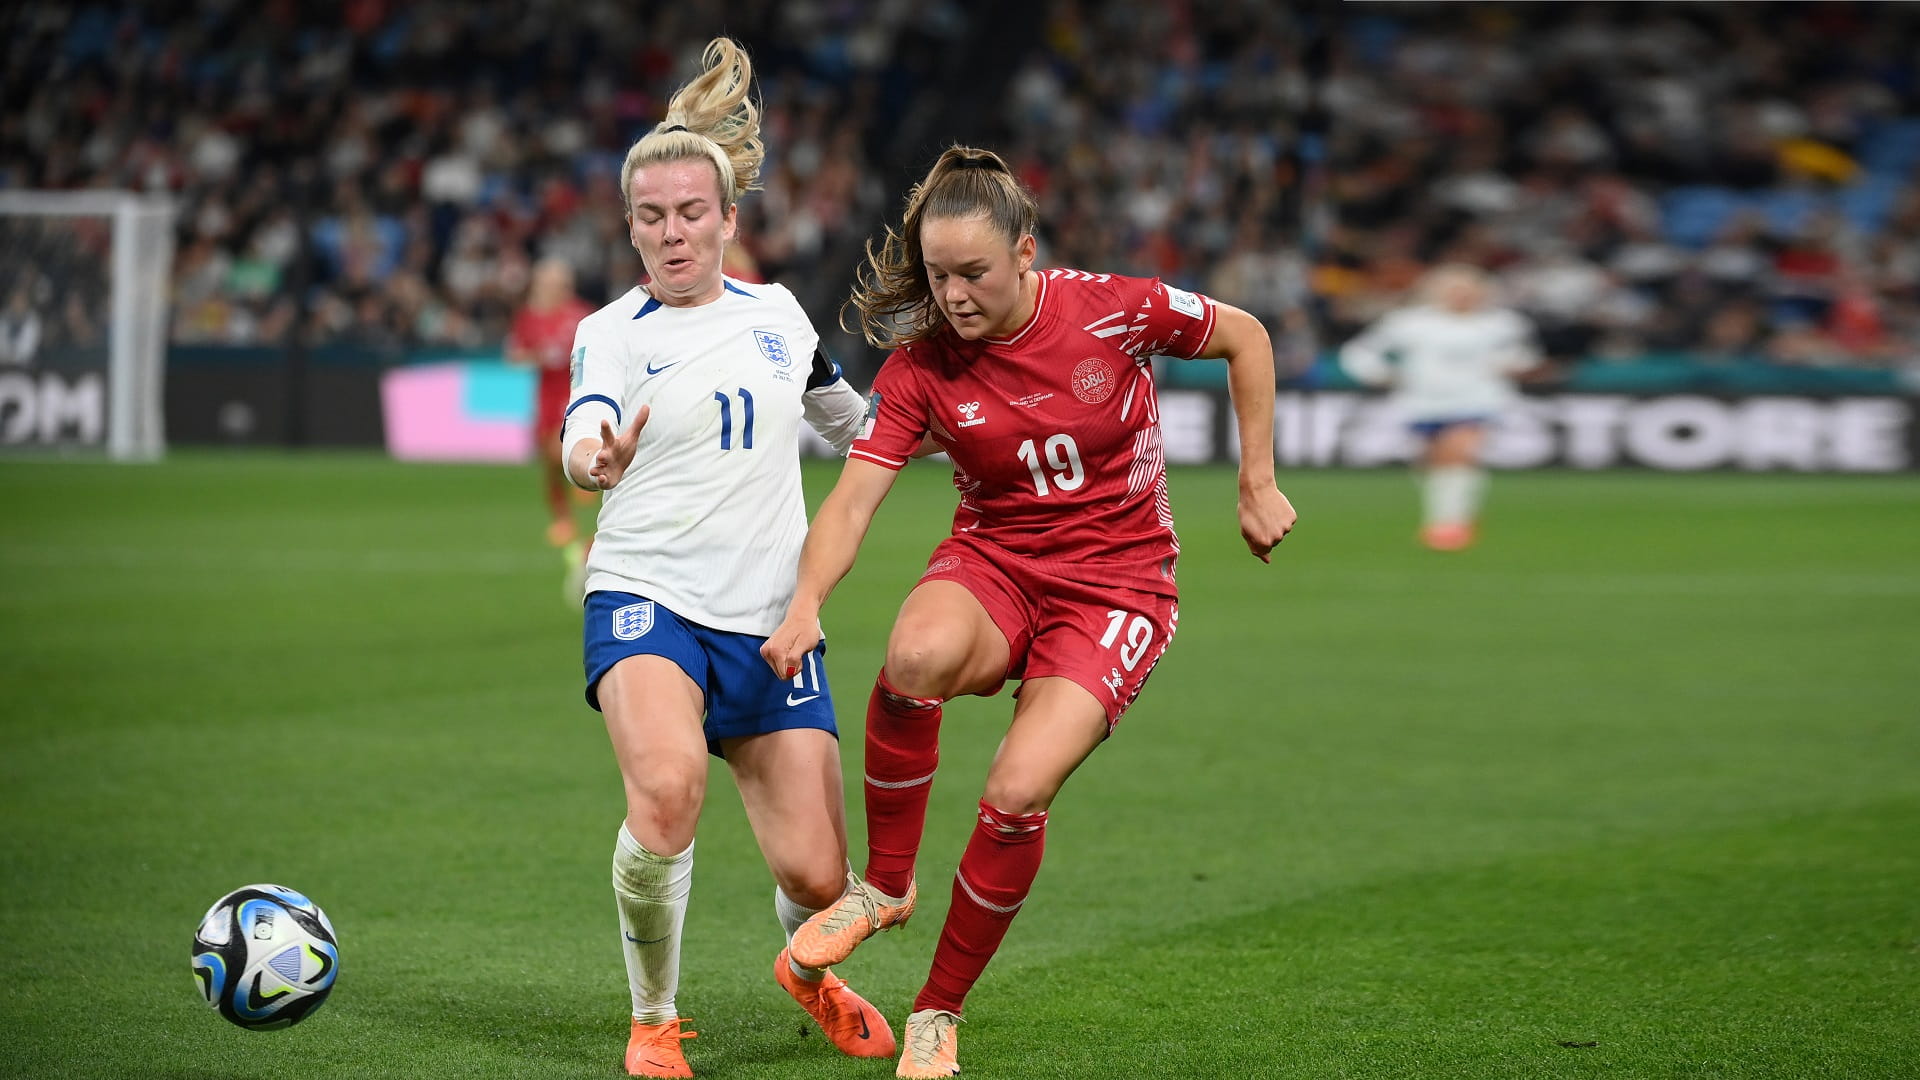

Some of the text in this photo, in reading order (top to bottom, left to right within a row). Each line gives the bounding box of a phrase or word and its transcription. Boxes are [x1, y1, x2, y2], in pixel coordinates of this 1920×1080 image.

[1080, 370, 1107, 391] DBU
[714, 387, 754, 450] 11
[957, 415, 986, 429] hummel
[1017, 433, 1085, 497] 19
[1099, 609, 1154, 672] 19
